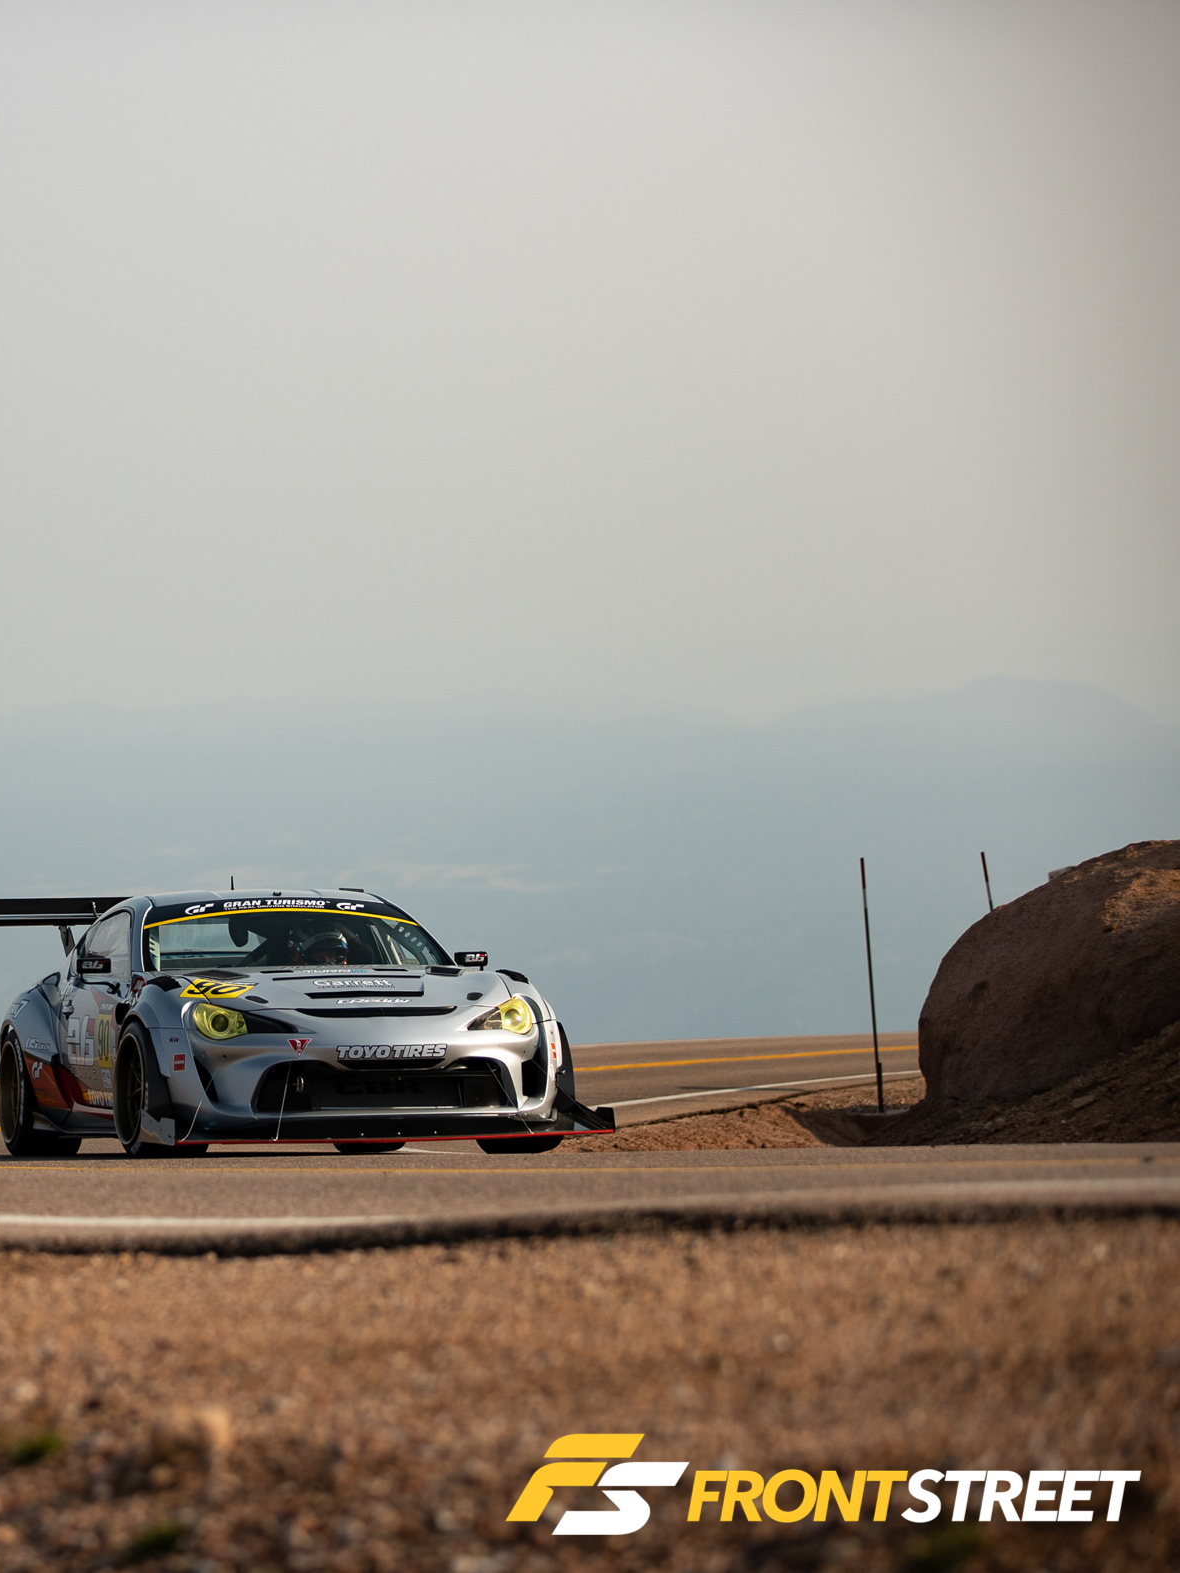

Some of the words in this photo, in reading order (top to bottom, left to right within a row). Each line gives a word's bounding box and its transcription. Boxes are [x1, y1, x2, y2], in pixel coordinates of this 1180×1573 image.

[223, 900, 262, 908] GRAN
[265, 899, 326, 907] TURISMO
[187, 981, 247, 996] 90
[97, 1018, 112, 1062] 90
[337, 1045, 394, 1060] TOYO
[393, 1043, 448, 1059] TIRES
